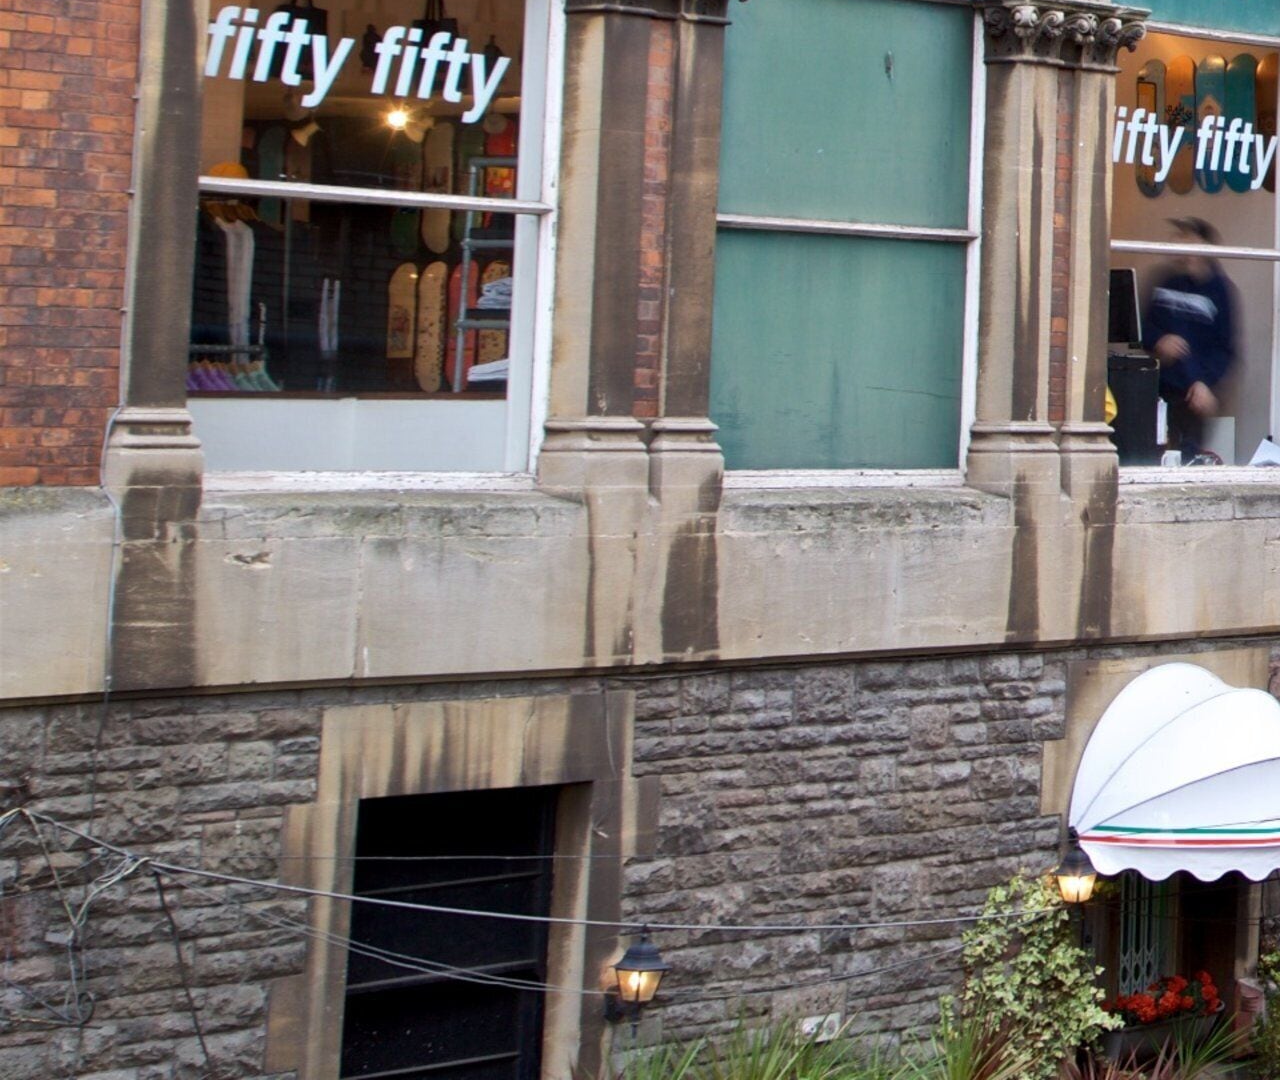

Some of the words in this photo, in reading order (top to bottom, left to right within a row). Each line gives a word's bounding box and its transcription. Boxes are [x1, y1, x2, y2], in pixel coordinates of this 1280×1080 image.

[204, 5, 355, 108] fifty
[371, 26, 511, 123] fifty
[1112, 106, 1185, 183] ifty
[1195, 114, 1277, 190] fifty
